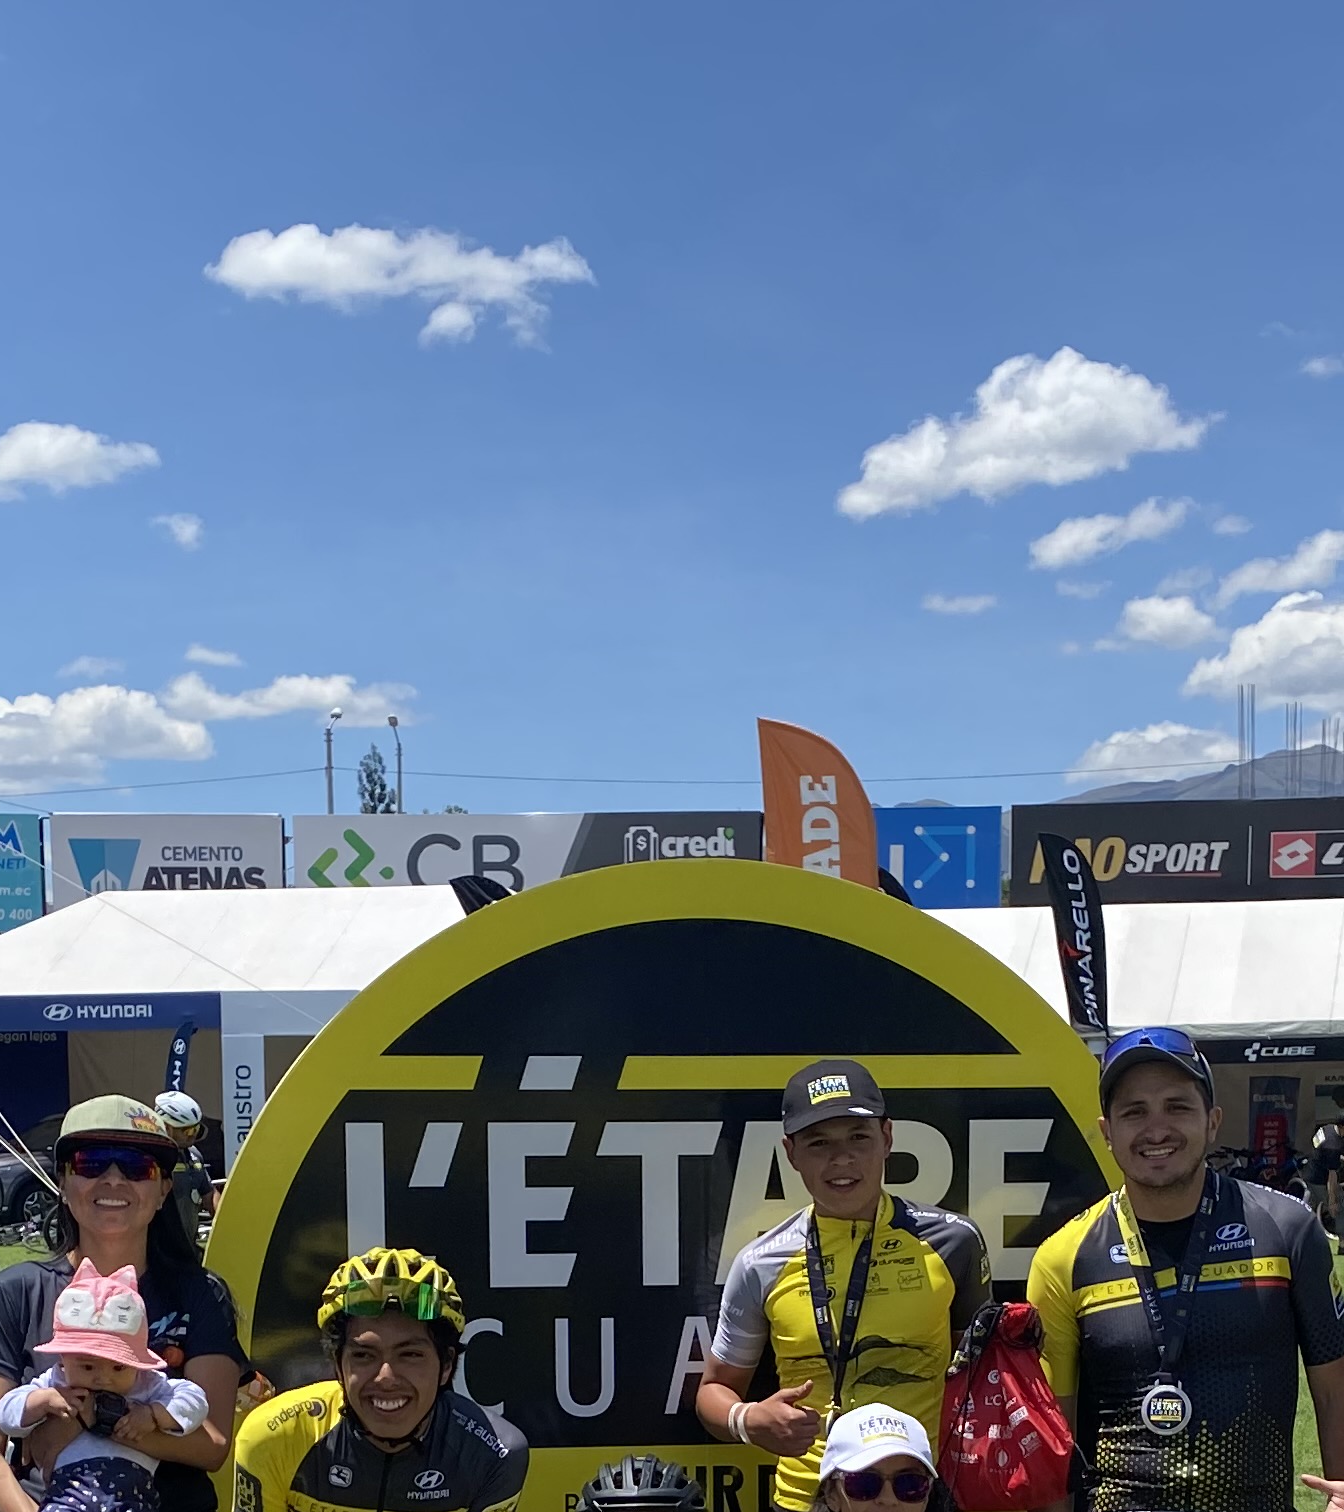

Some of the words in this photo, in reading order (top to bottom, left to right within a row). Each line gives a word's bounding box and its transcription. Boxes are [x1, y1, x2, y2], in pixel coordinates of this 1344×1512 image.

[661, 827, 736, 857] credi
[160, 846, 243, 862] CEMENTO
[8, 909, 33, 920] 400
[1062, 847, 1104, 1029] PINARELLO
[77, 1004, 153, 1018] HYUNDAI
[1260, 1045, 1316, 1057] CUBE
[1208, 1238, 1255, 1253] HYUNDAI
[858, 1413, 908, 1432] L'ÉTAPE
[407, 1489, 450, 1500] HYUNDAI
